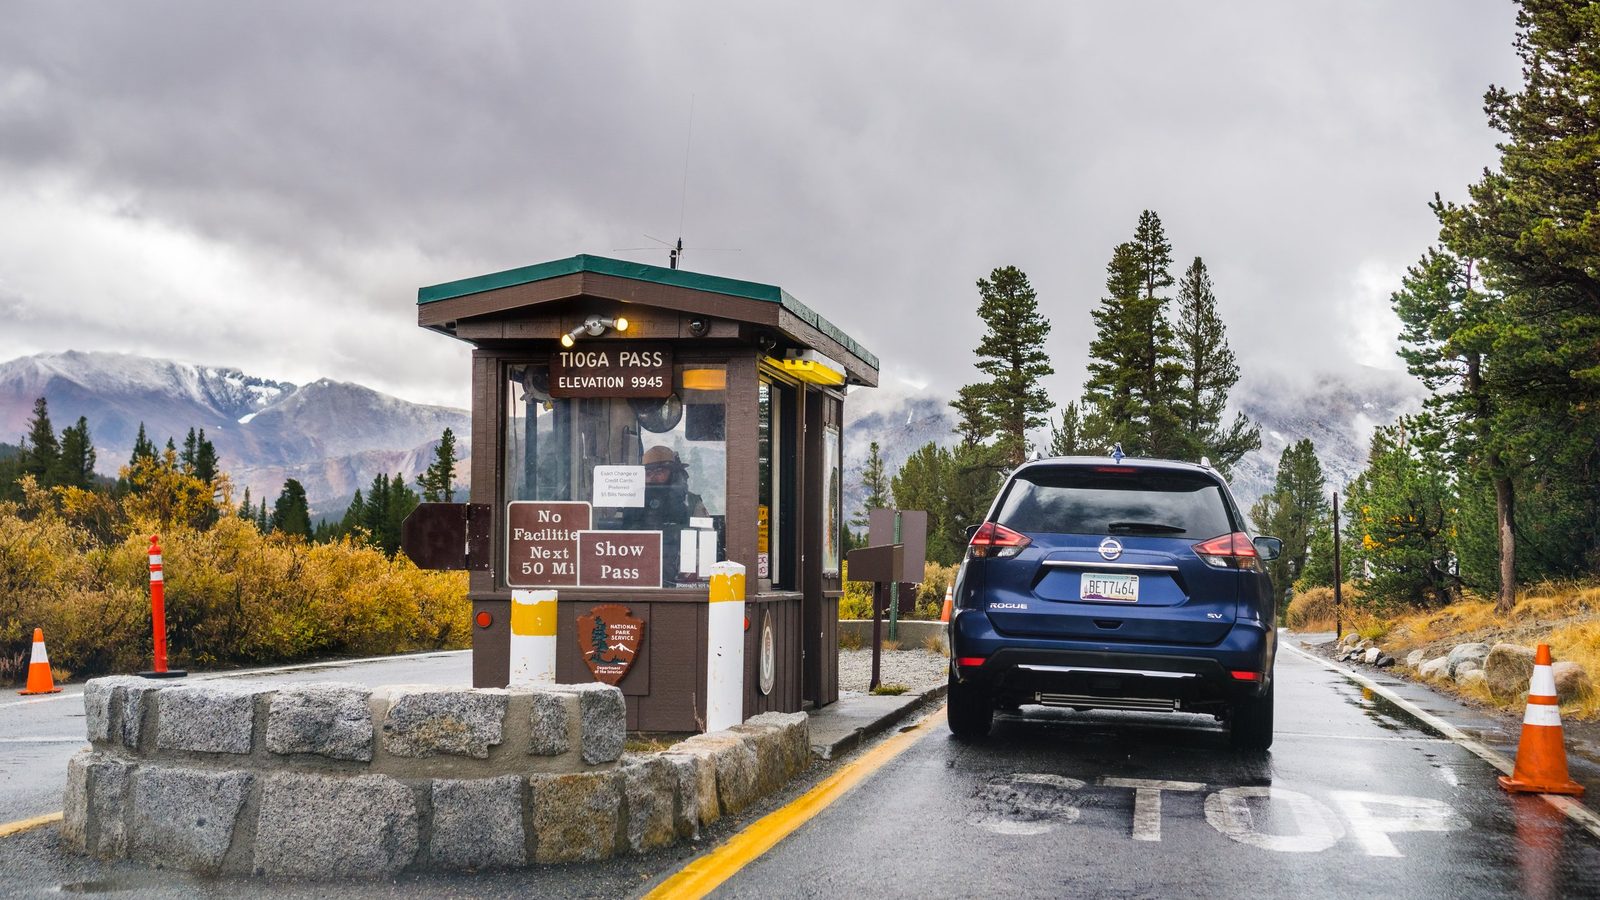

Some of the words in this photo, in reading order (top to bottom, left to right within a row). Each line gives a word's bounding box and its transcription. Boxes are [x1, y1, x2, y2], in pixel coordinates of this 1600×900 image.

[560, 352, 609, 367] TIOGA
[620, 352, 663, 367] PASS
[559, 377, 624, 388] ELEVATION
[631, 377, 663, 388] 9945
[538, 510, 562, 523] No
[514, 528, 578, 541] Facilitie
[530, 546, 569, 559] Next
[595, 541, 645, 557] Show
[522, 562, 544, 575] 50
[552, 562, 575, 575] Mi
[601, 565, 640, 579] Pass
[1089, 580, 1134, 595] BET7464
[970, 773, 1473, 858] STOP
